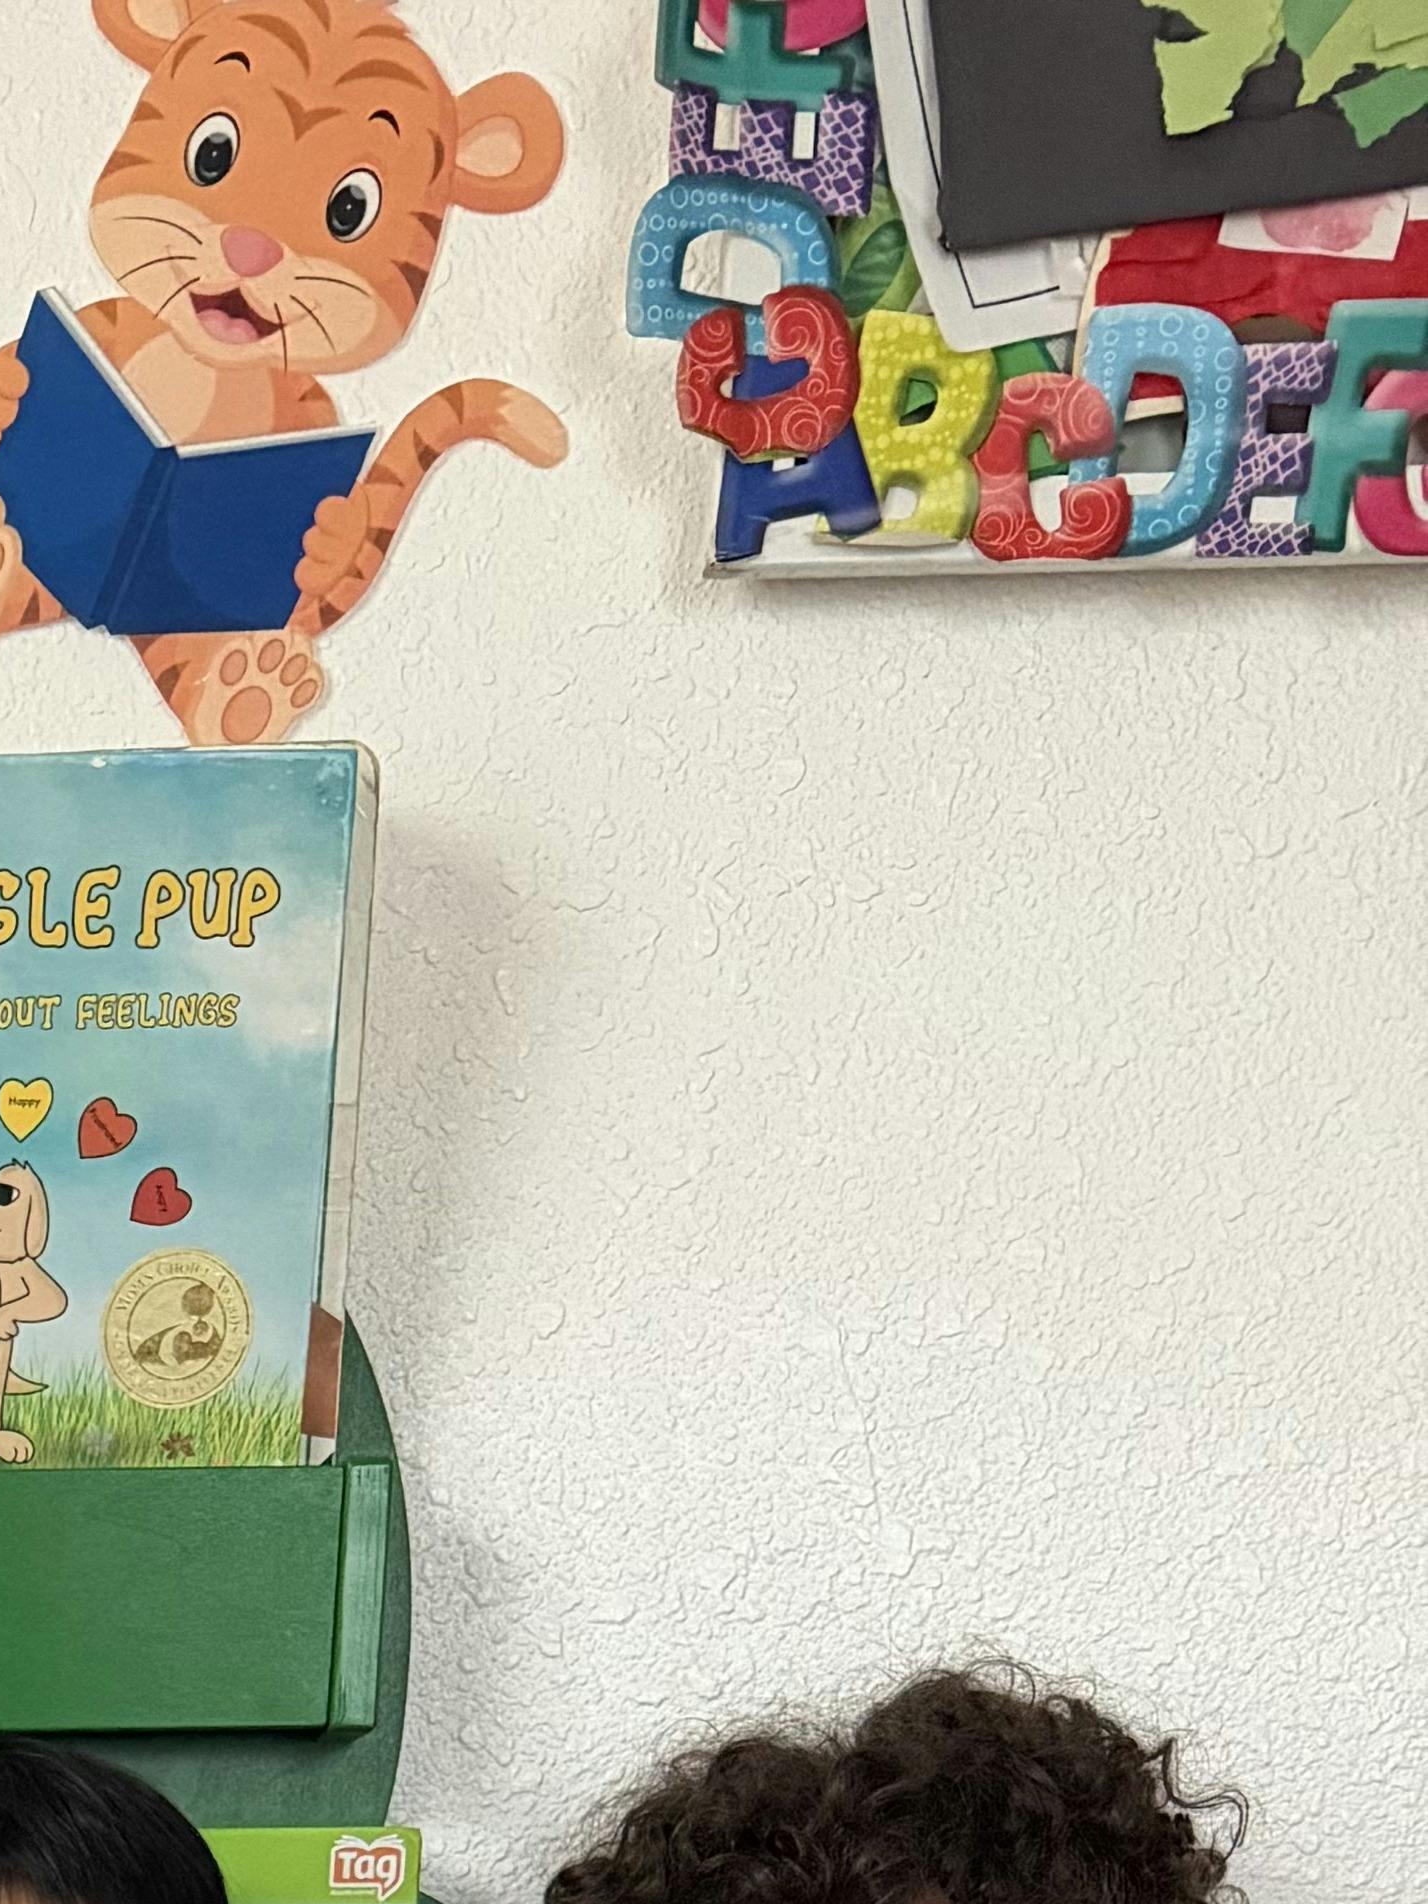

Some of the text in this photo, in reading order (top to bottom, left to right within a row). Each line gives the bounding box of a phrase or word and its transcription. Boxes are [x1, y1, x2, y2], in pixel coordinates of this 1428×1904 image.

[137, 867, 282, 950] PUP
[76, 993, 241, 1029] FEELINGS
[337, 1851, 398, 1889] Tag
